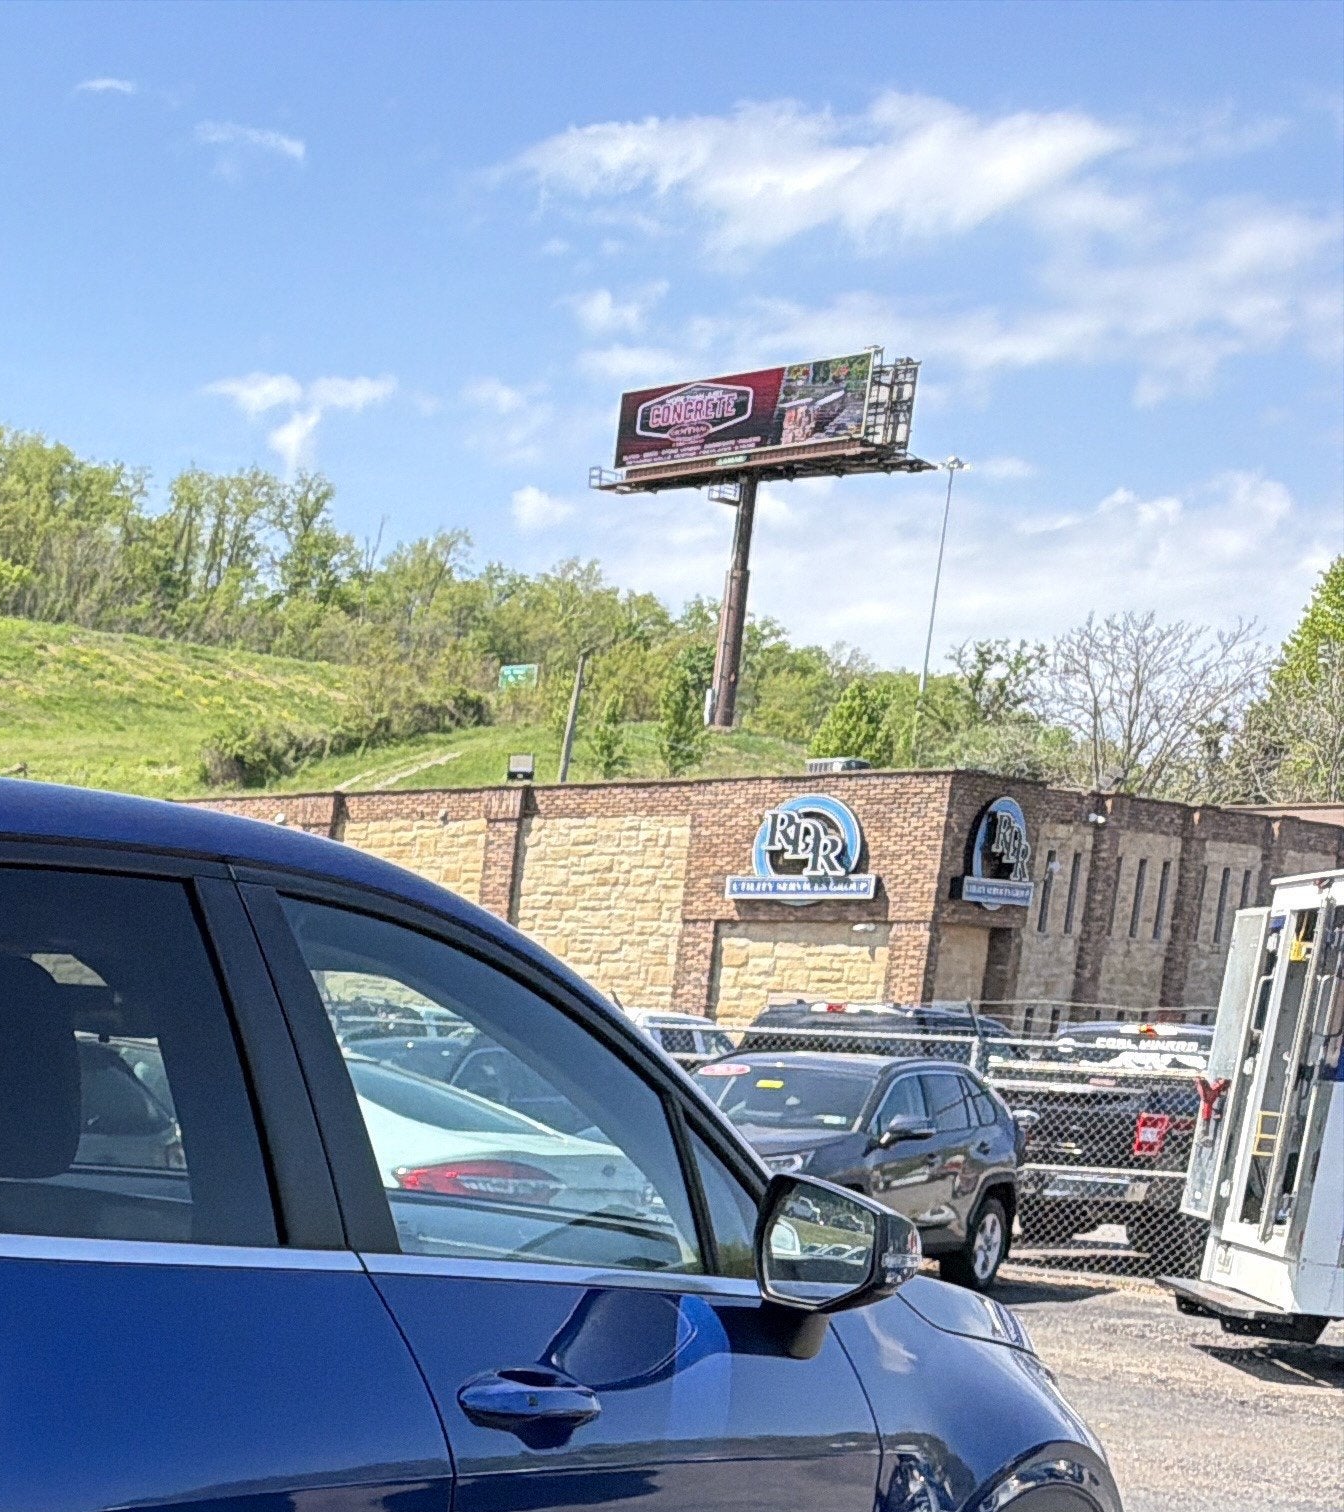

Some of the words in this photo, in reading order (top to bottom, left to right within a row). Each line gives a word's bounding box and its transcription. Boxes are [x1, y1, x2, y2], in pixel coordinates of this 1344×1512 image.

[649, 393, 737, 428] CONCRETE
[761, 810, 845, 876] RDR
[991, 811, 1031, 881] RDR
